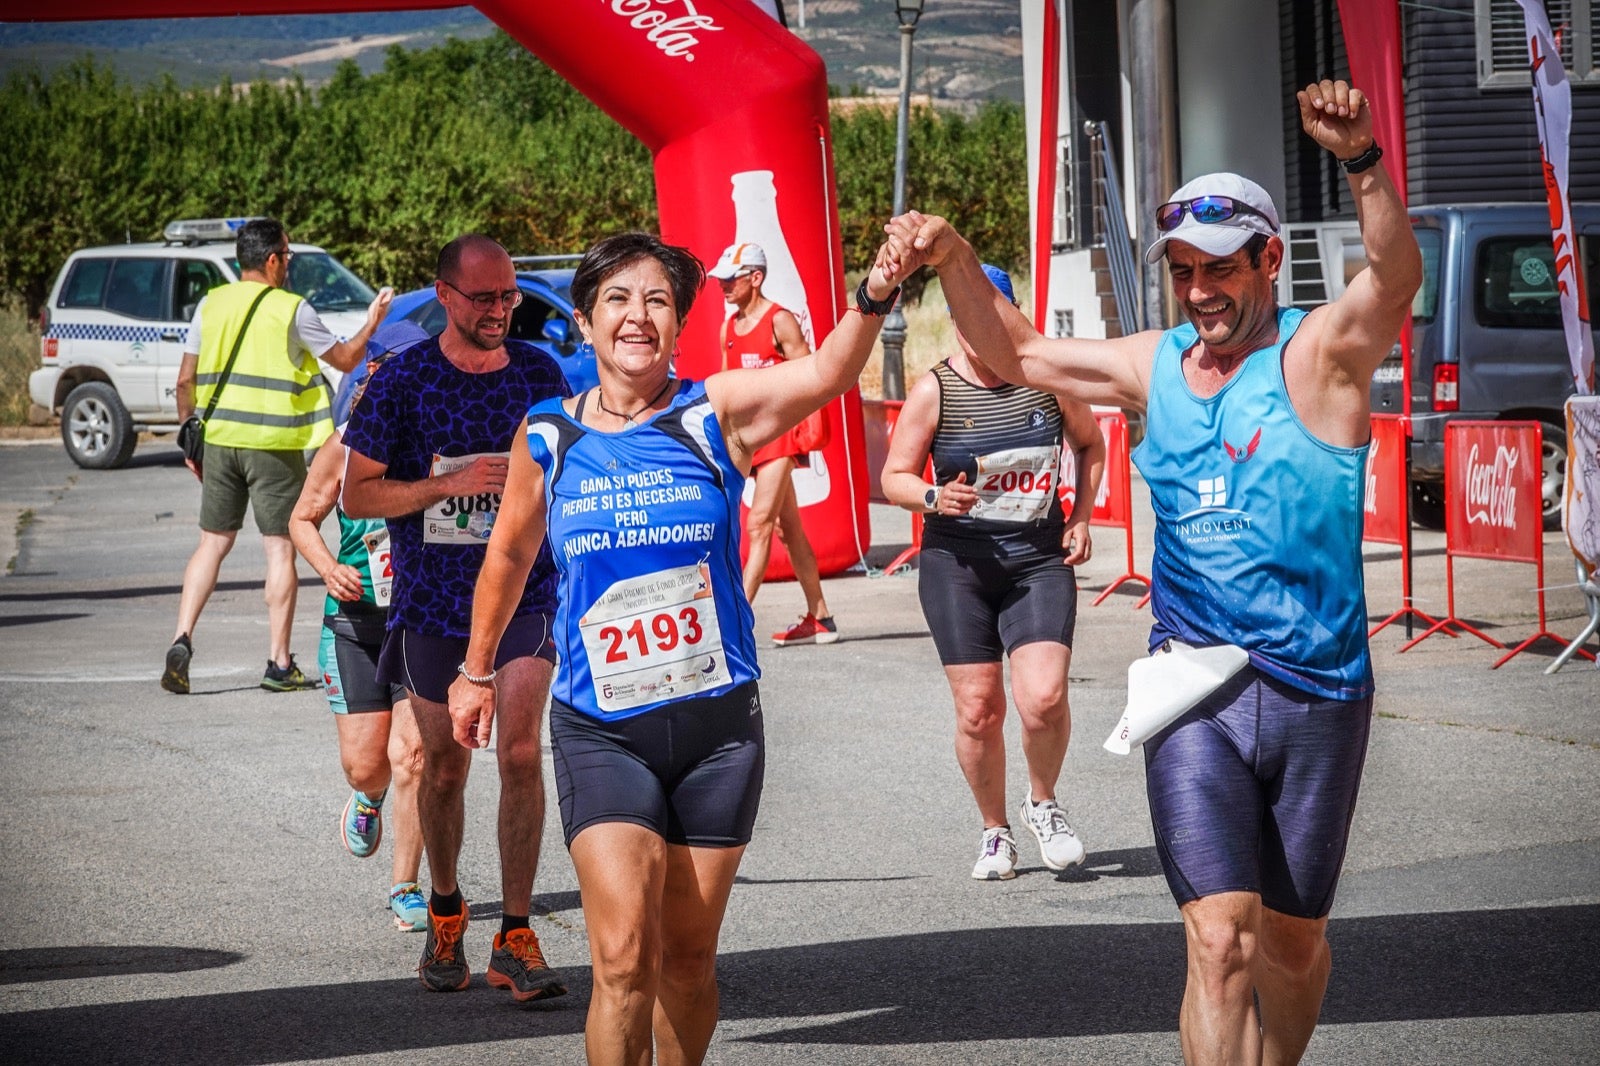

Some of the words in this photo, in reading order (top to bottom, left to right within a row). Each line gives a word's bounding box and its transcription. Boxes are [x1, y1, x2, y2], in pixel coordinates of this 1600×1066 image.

[580, 475, 612, 495] GANA
[614, 475, 625, 489] SI
[627, 468, 674, 488] PUEDES
[981, 470, 1052, 495] 2004
[562, 496, 598, 519] PIERDE
[601, 493, 613, 510] SI
[616, 492, 632, 509] ES
[634, 485, 702, 507] NECESARIO
[614, 509, 648, 528] PERO
[1175, 517, 1252, 536] INNOVENT
[615, 523, 715, 548] ABANDONES!
[599, 606, 703, 664] 2193
